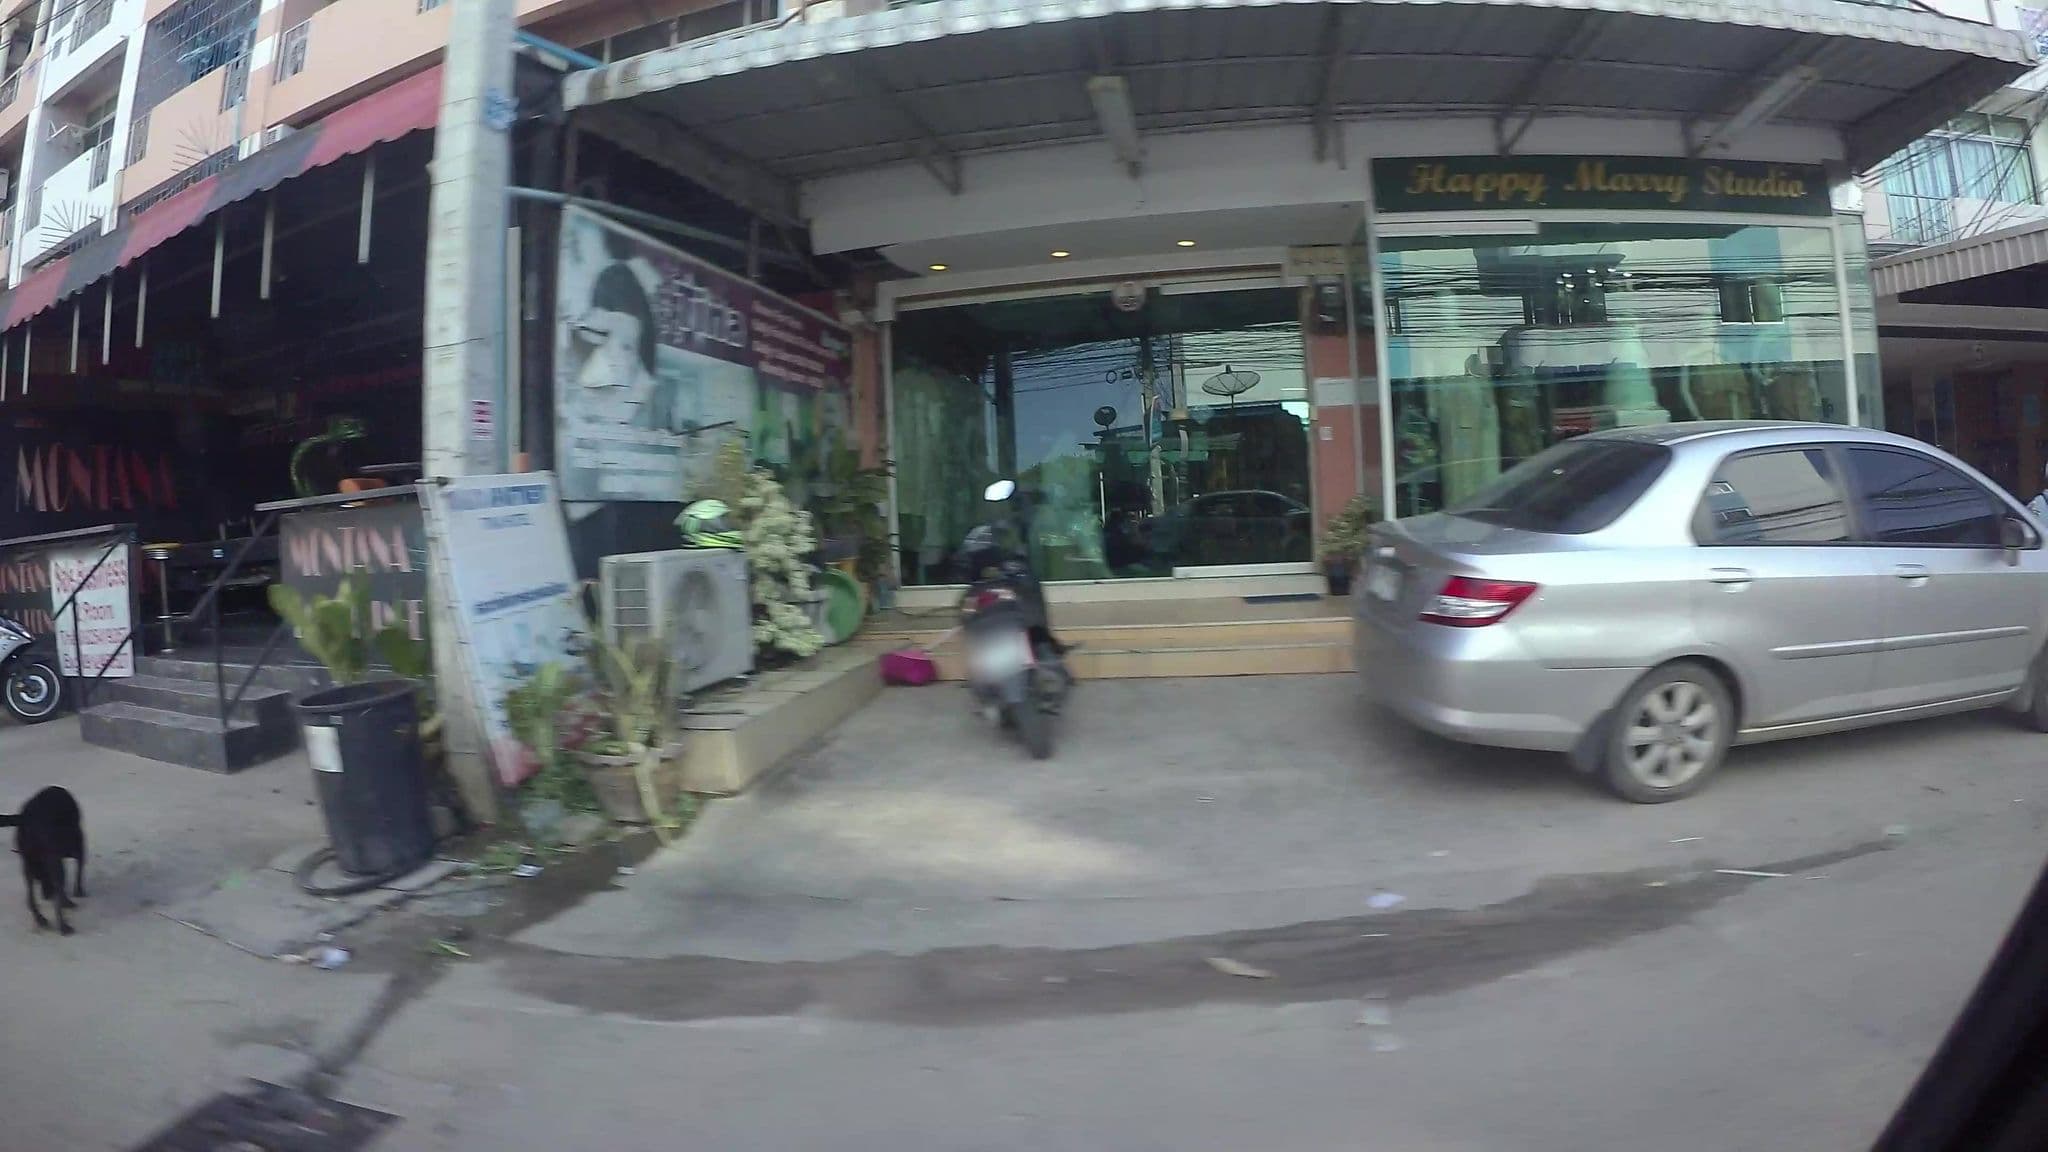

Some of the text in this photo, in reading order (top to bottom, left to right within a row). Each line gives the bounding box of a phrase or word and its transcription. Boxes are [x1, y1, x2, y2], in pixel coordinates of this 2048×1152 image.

[1406, 160, 1807, 202] Happy Marry Studio
